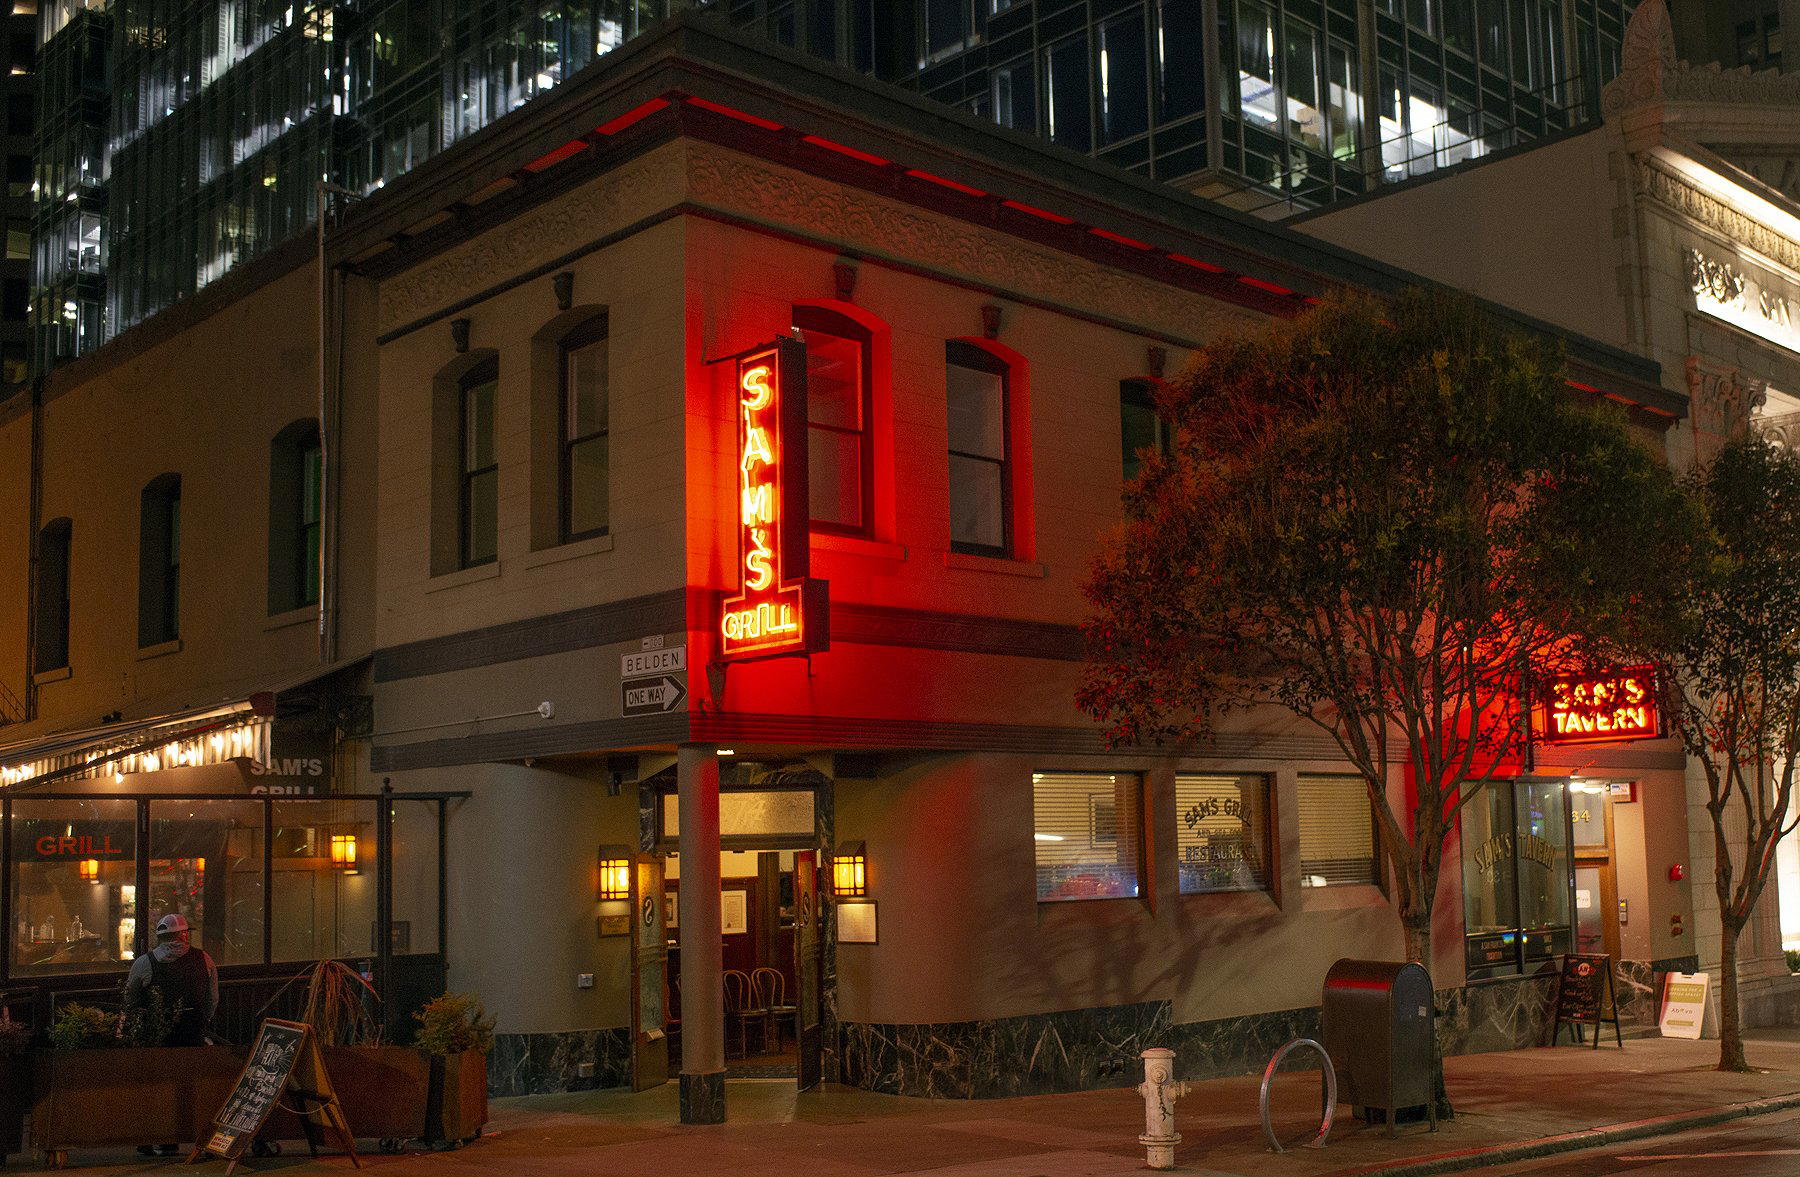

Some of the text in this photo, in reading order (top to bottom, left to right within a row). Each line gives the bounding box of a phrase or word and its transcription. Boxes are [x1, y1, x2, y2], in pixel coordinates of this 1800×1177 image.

[740, 366, 774, 592] SAM'S
[722, 602, 798, 640] GRILL
[626, 652, 680, 673] BELDEN
[628, 686, 667, 706] ONE WAY
[1553, 678, 1646, 710] SAM'S
[1552, 706, 1646, 734] TAVERN
[250, 758, 323, 776] SAM'S
[250, 785, 321, 803] GRILL
[1184, 795, 1219, 830] SAM'S
[35, 835, 122, 856] GRILL
[1474, 832, 1556, 874] SAM'S TAVERN
